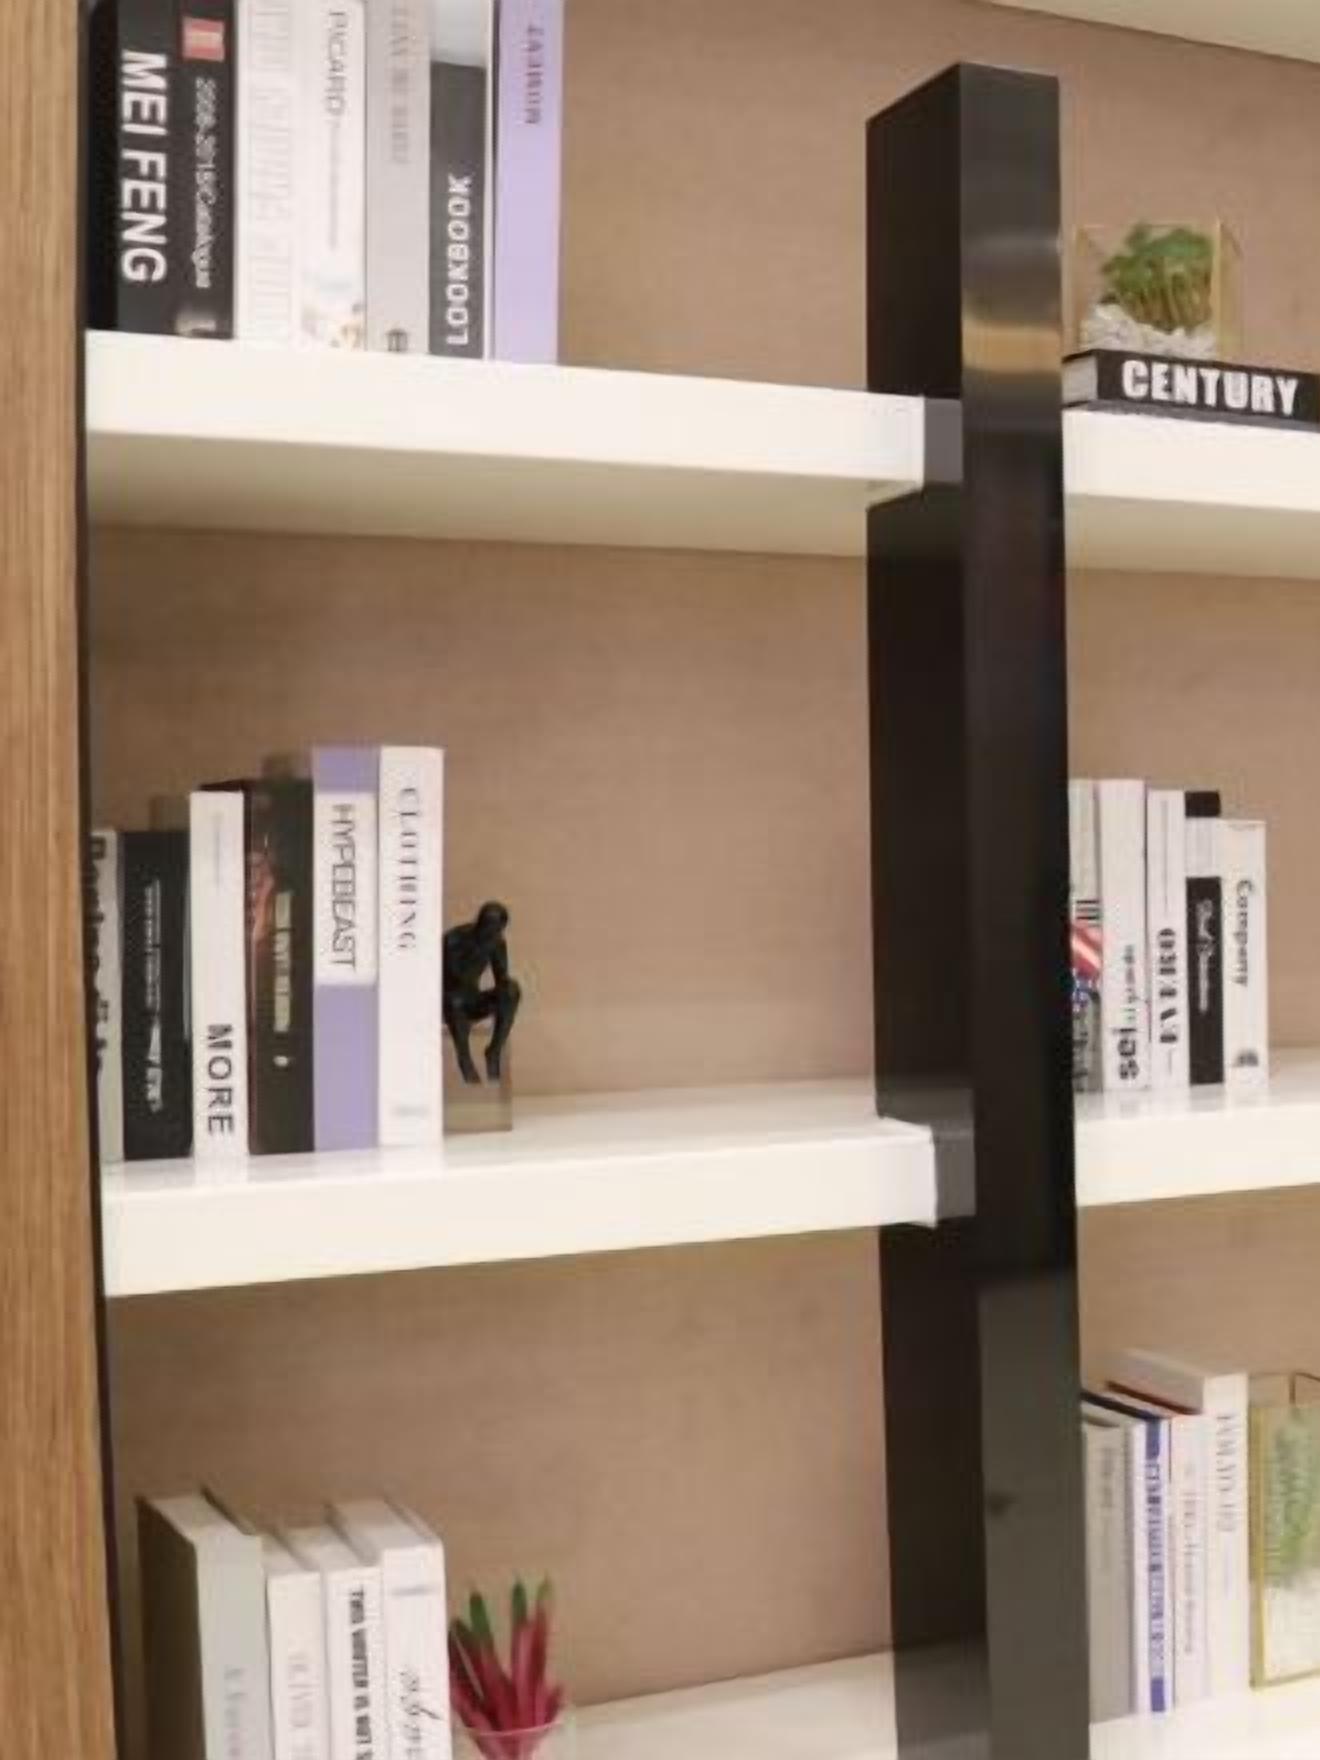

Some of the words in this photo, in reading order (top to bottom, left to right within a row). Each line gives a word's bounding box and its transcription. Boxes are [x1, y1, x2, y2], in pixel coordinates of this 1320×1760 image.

[120, 49, 168, 136] MEI
[120, 149, 168, 283] FENG
[445, 172, 473, 346] LOOKBOOK
[1121, 359, 1299, 415] CENTURY
[330, 802, 357, 969] HYPEBEAST
[397, 786, 421, 950] CLOTHING
[1231, 879, 1253, 988] Company
[206, 1023, 235, 1136] MORE
